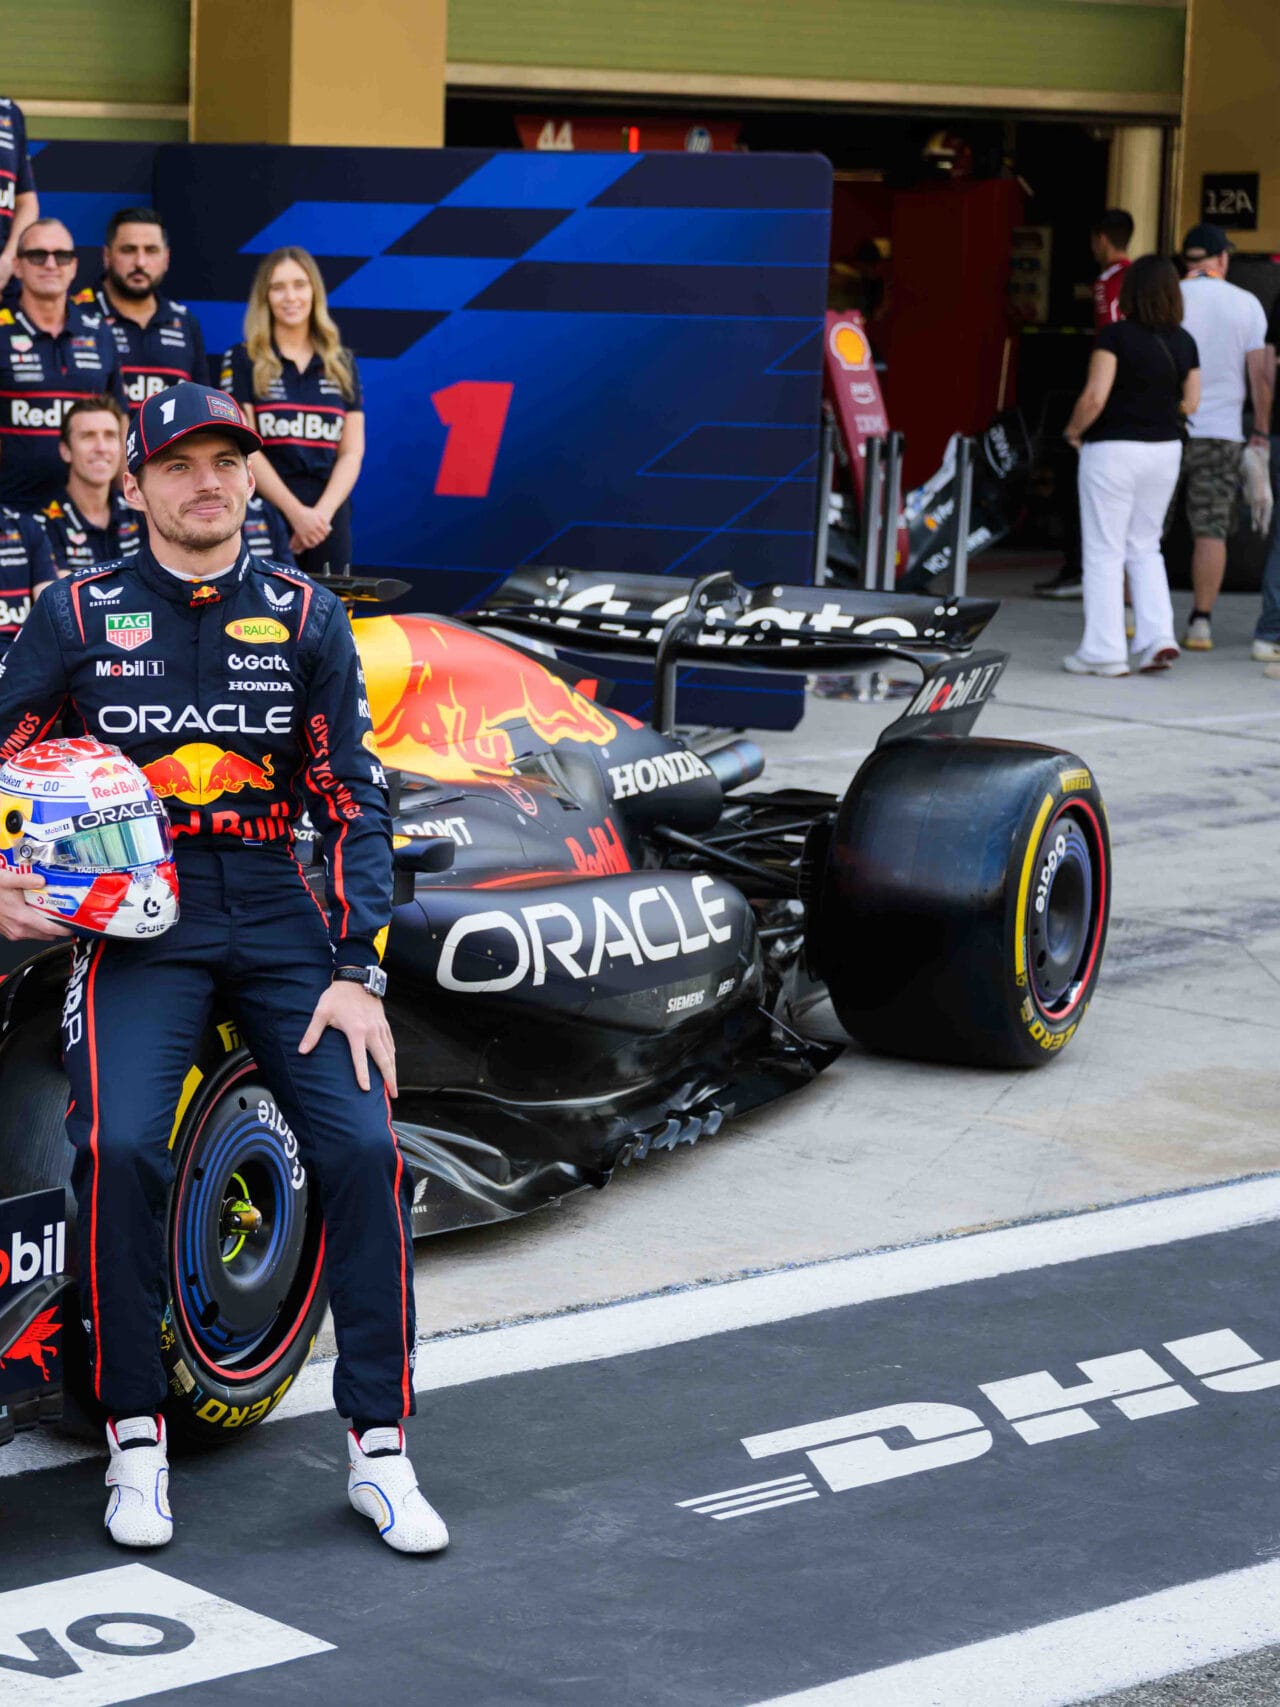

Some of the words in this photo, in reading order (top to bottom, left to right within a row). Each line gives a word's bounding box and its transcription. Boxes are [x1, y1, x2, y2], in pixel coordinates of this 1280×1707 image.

[535, 120, 575, 151] 44
[1204, 189, 1255, 214] 12A
[160, 399, 176, 425] 1
[431, 381, 514, 498] 1
[109, 615, 149, 630] TAG
[243, 625, 282, 638] RAUCH
[108, 629, 150, 648] HEUER
[95, 661, 145, 677] Mobil
[228, 681, 294, 692] HONDA
[907, 667, 982, 717] Mobil
[98, 704, 294, 734] ORACLE
[608, 750, 712, 800] HONDA
[78, 800, 161, 829] ORACLE
[436, 874, 732, 993] ORACLE
[666, 989, 705, 1014] SIEMENS
[195, 1374, 294, 1428] ZERO
[740, 1327, 1280, 1493] DHL
